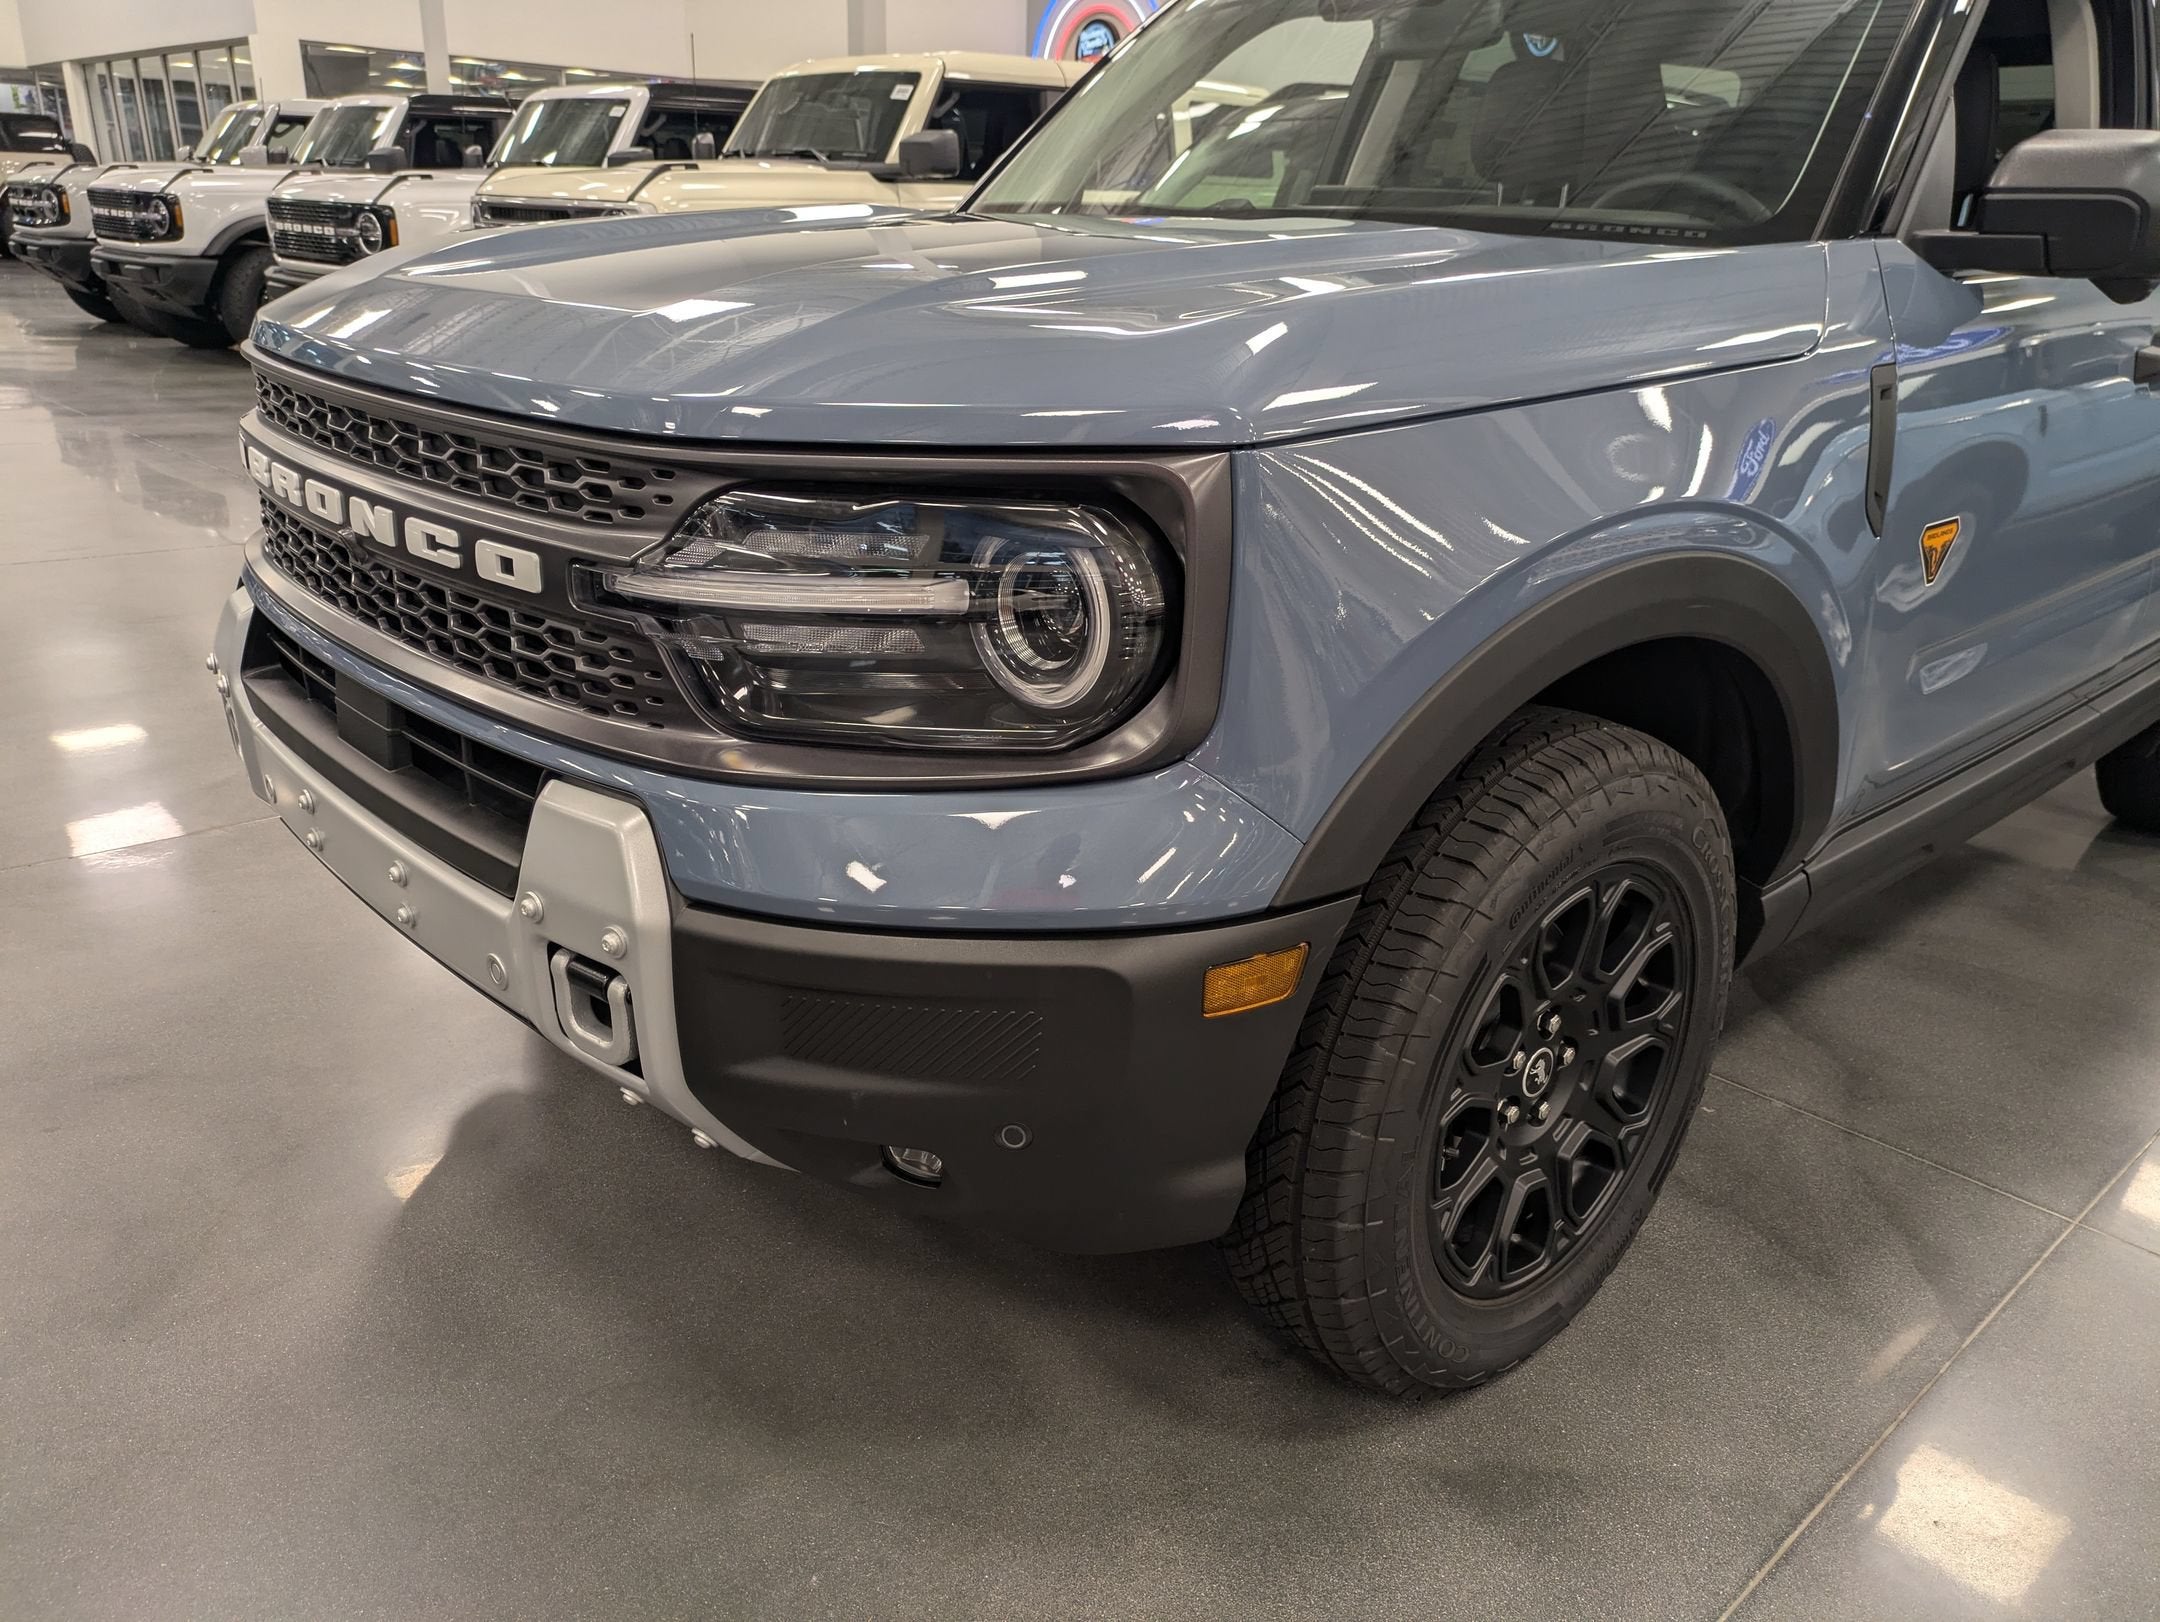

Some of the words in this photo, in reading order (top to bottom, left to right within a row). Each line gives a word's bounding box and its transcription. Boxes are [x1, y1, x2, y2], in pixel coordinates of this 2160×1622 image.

[275, 222, 336, 236] BRONCO
[1549, 221, 1708, 240] BRONCO
[1740, 430, 1770, 477] Ford
[247, 445, 544, 594] BRONCO
[1508, 847, 1575, 931] Continental
